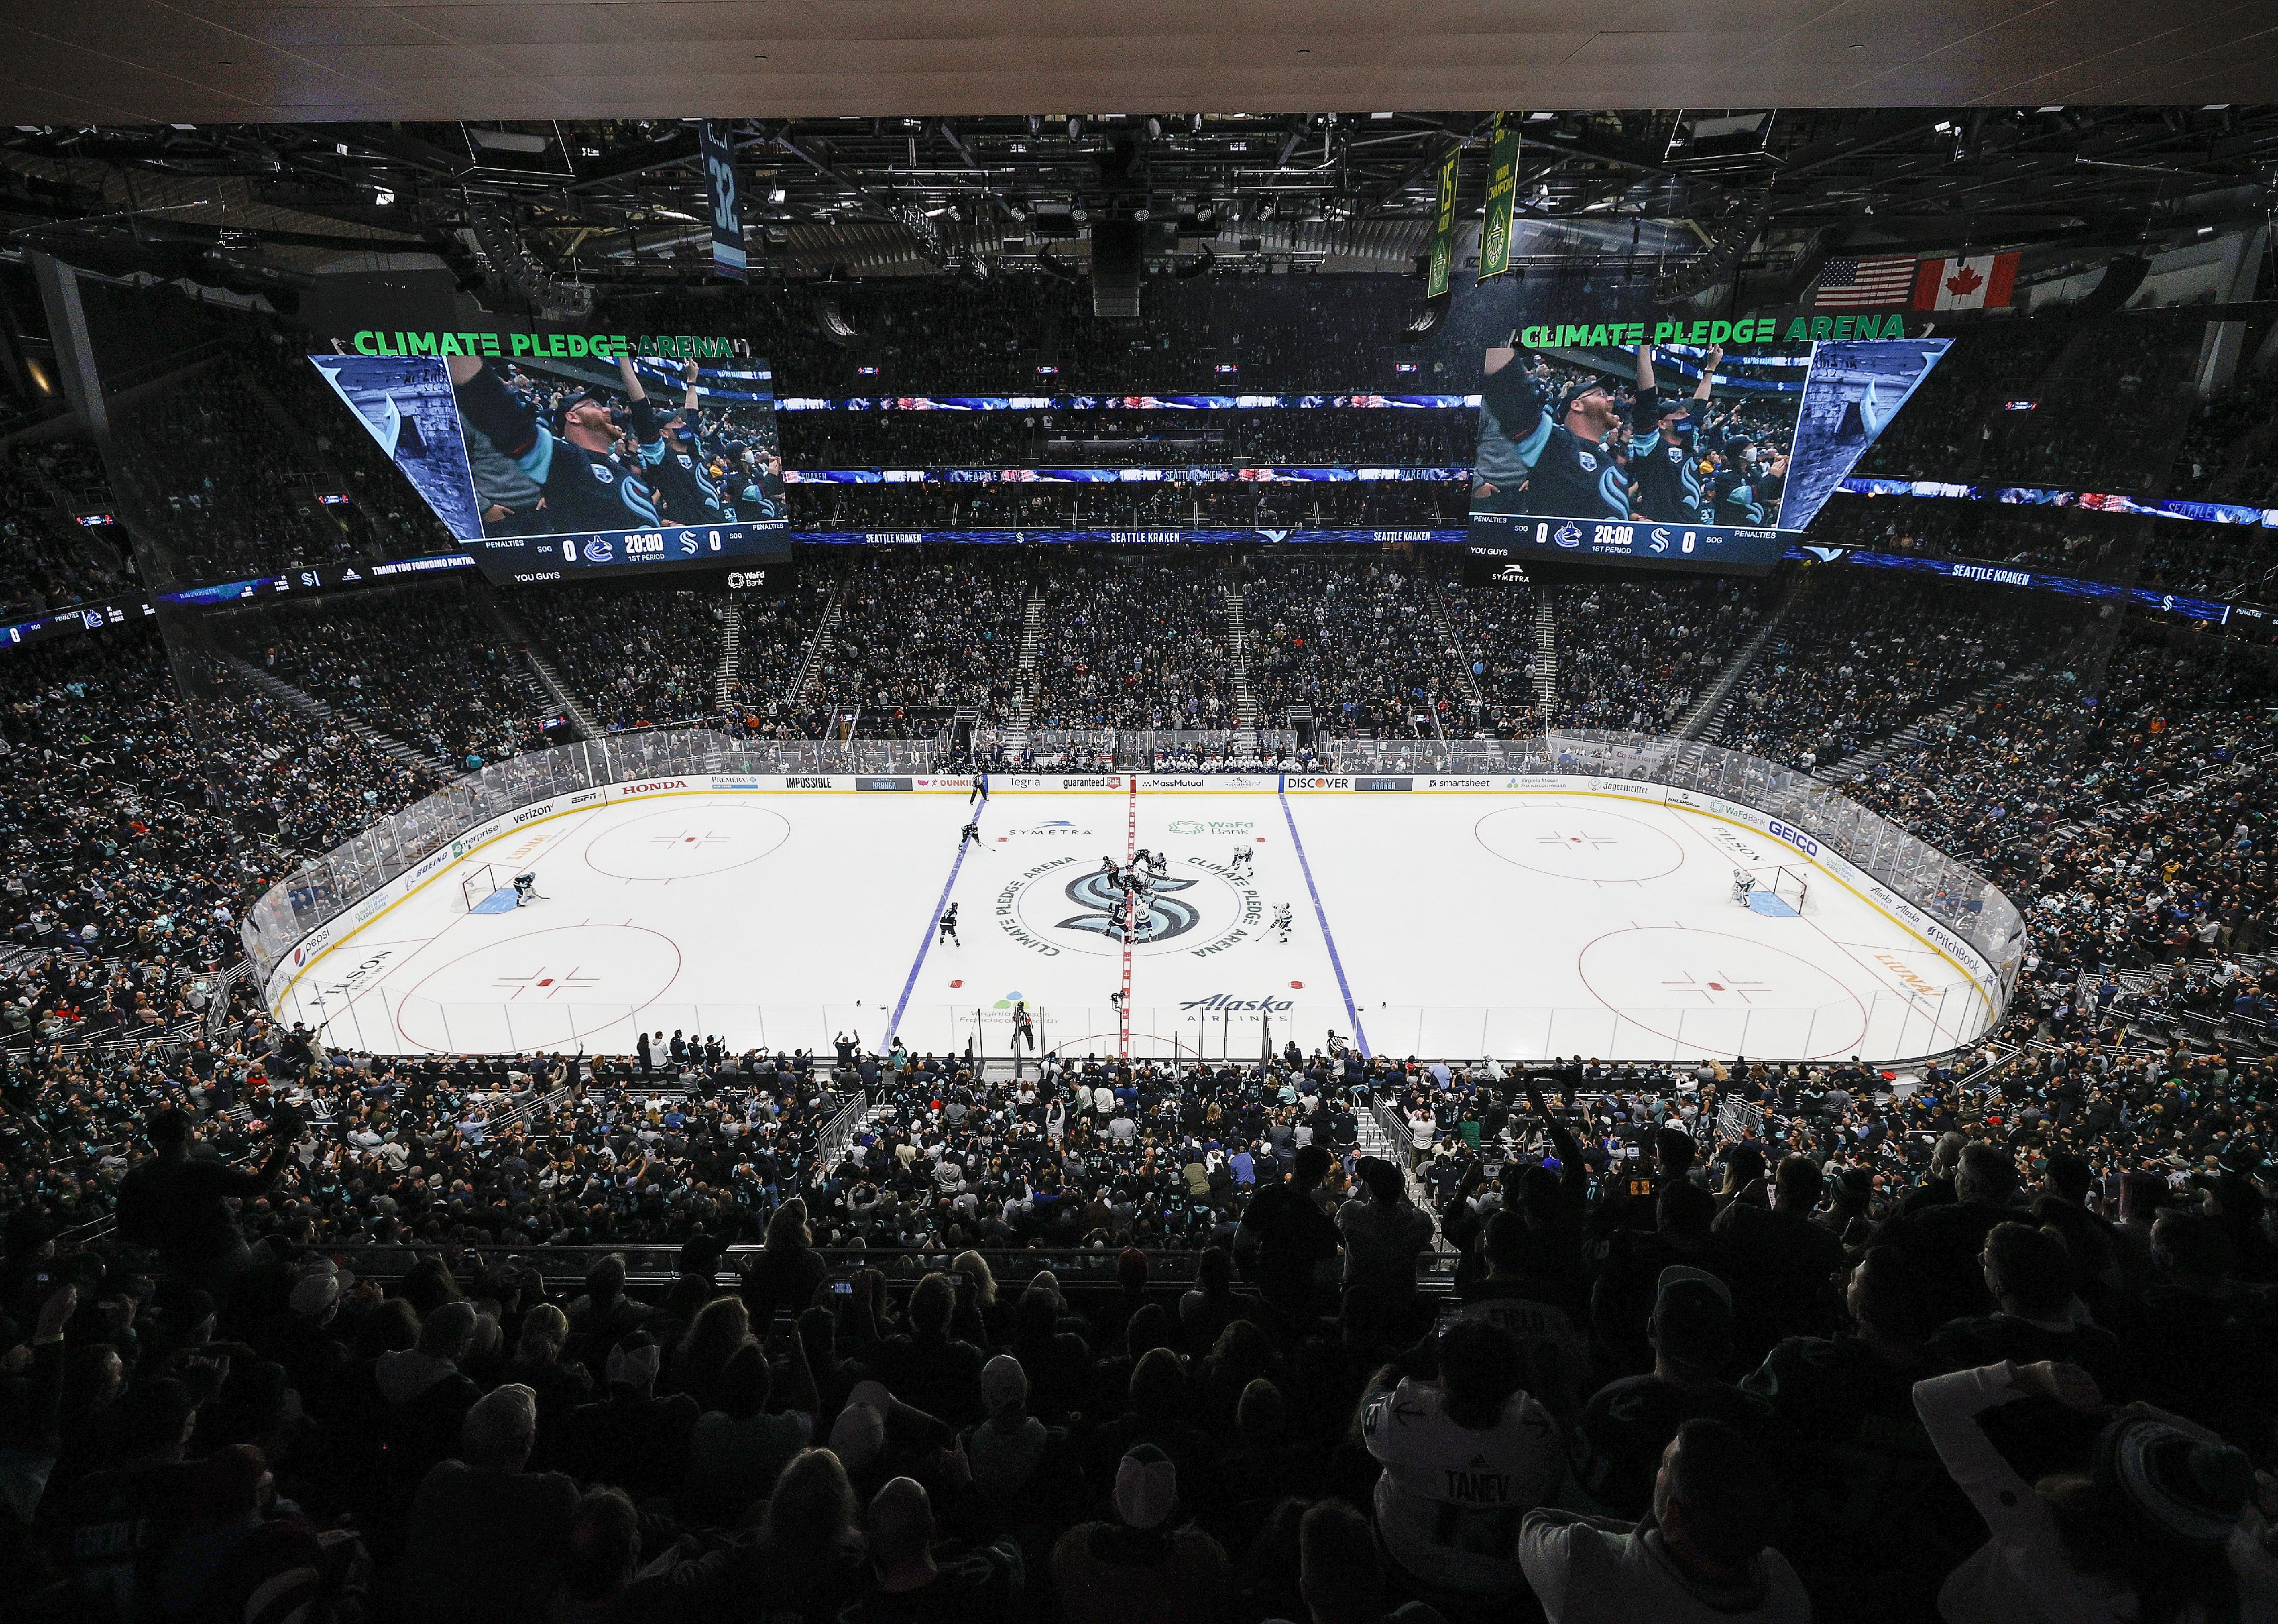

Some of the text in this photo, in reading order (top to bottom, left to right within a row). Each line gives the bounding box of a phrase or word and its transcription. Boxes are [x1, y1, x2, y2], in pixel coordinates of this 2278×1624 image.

[709, 156, 739, 234] 32
[1523, 315, 1905, 348] CLIMATE PLEDGE ARENA
[354, 330, 734, 358] CLIMATE PLEDGE ARENA
[1400, 470, 1427, 480] RAKEN
[709, 531, 721, 551] 0
[866, 533, 922, 544] SEATTLE KRAKEN
[1111, 532, 1180, 542] SEATTLE KRAKEN
[1374, 532, 1431, 542] SEATTLE KRAKEN
[1536, 523, 1548, 543] 0
[1594, 525, 1633, 545] 20:00
[1682, 531, 1696, 553] 0
[1734, 531, 1776, 539] PENALTIES
[563, 540, 577, 561] 0
[624, 533, 663, 553] 20:00
[372, 565, 397, 576] THANK
[397, 563, 411, 572] YOU
[411, 559, 447, 570] FOUNDING
[515, 572, 560, 582] YOU GUYS
[744, 571, 765, 580] WaFd
[1952, 565, 2030, 586] SEATTLE KRAKEN
[1492, 573, 1530, 582] SYMETRA
[55, 613, 79, 622] PENALTIES
[2236, 609, 2263, 618] PENALTIES
[10, 627, 21, 643] 0
[622, 781, 688, 795] HONDA
[786, 777, 832, 788] IMPOSSIBLE
[1009, 777, 1040, 789] Tegria
[1063, 777, 1105, 789] guaranteed
[1289, 778, 1348, 788] DISCOVER
[1439, 778, 1490, 787] smartsheet
[514, 804, 551, 823] verizon
[1726, 806, 1766, 826] WaFd Bank
[455, 823, 499, 852] enterprise
[1768, 821, 1817, 856] GEICO
[417, 852, 447, 878] BOEING
[1870, 887, 1892, 904] Alaska
[996, 856, 1078, 956] CLIMATE PLEDGE ARENA
[1117, 909, 1124, 919] 19
[1188, 858, 1262, 958] CLIMATE PLEDGE ARENA
[1896, 904, 1920, 923] Alaska
[306, 927, 329, 954] pepsi
[307, 951, 393, 1007] FILSON
[1177, 994, 1294, 1013] Alaska
[1445, 1470, 1511, 1503] TANEV
